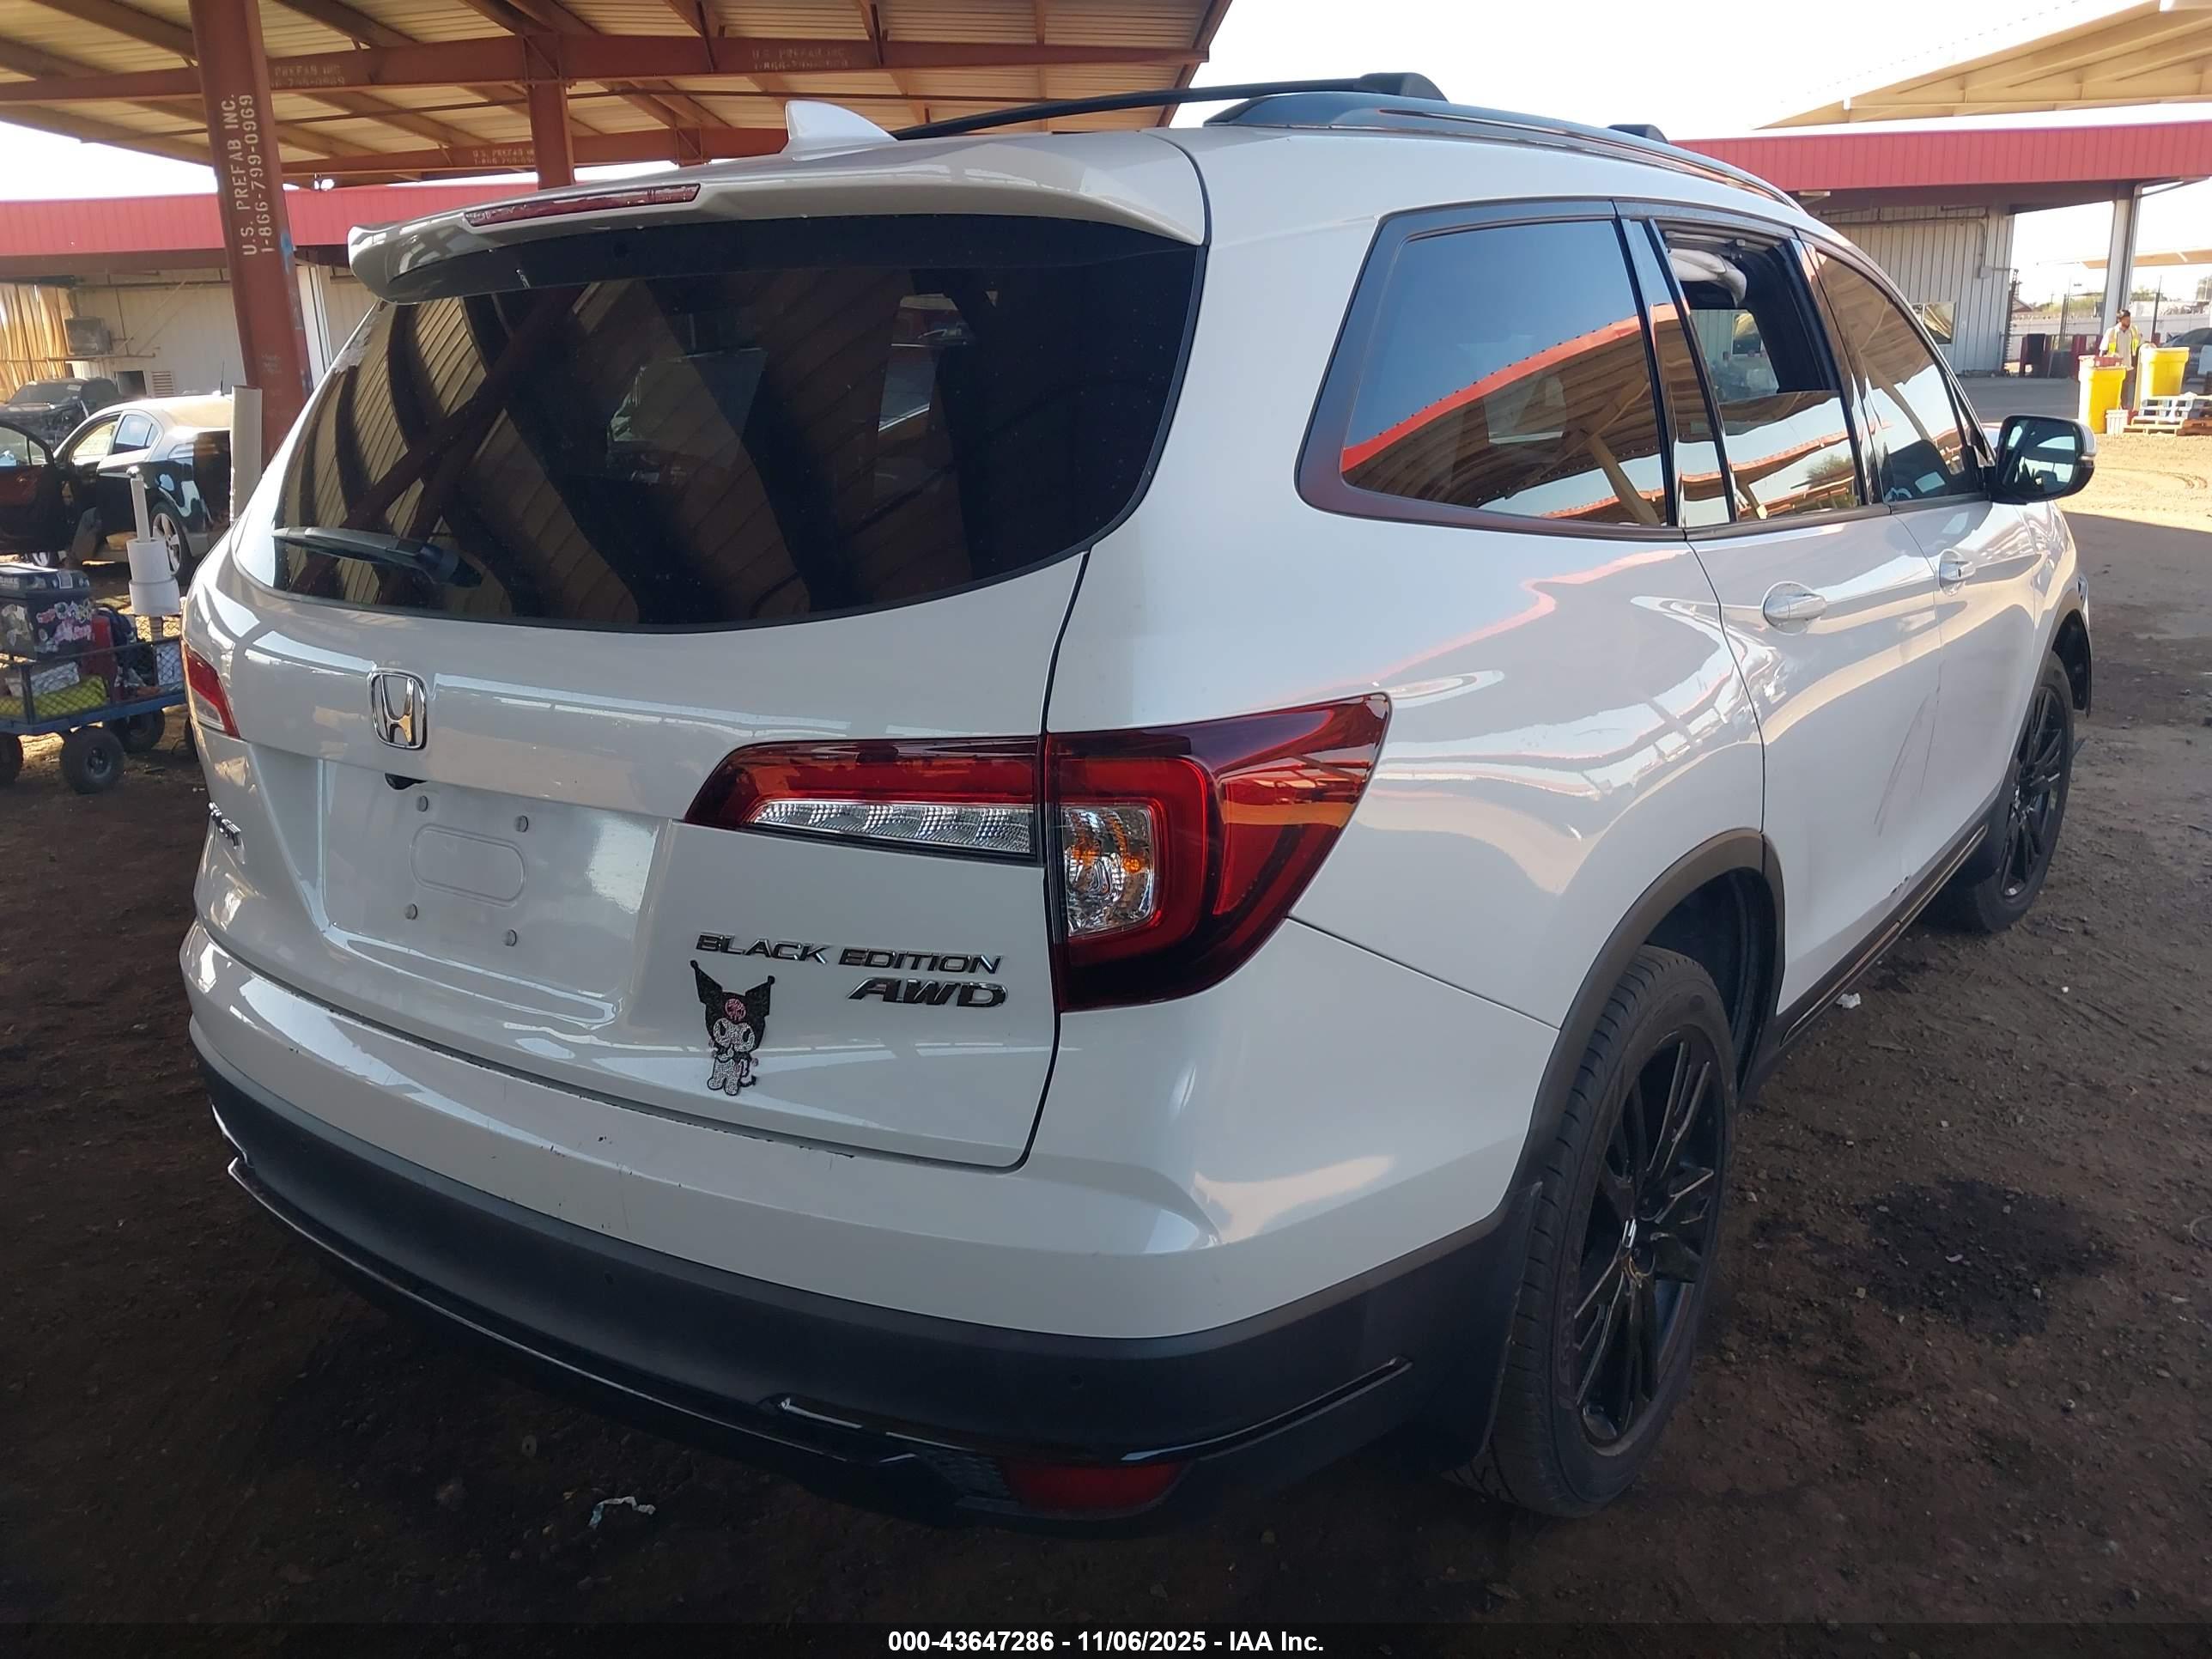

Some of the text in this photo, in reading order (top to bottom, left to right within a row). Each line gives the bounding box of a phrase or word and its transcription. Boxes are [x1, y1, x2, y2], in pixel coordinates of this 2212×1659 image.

[221, 94, 258, 255] U.S. PREFAB INC.
[239, 94, 275, 253] 1-866-799-0969
[696, 932, 1004, 975] BLACK EDITION
[846, 975, 1009, 1008] AWD
